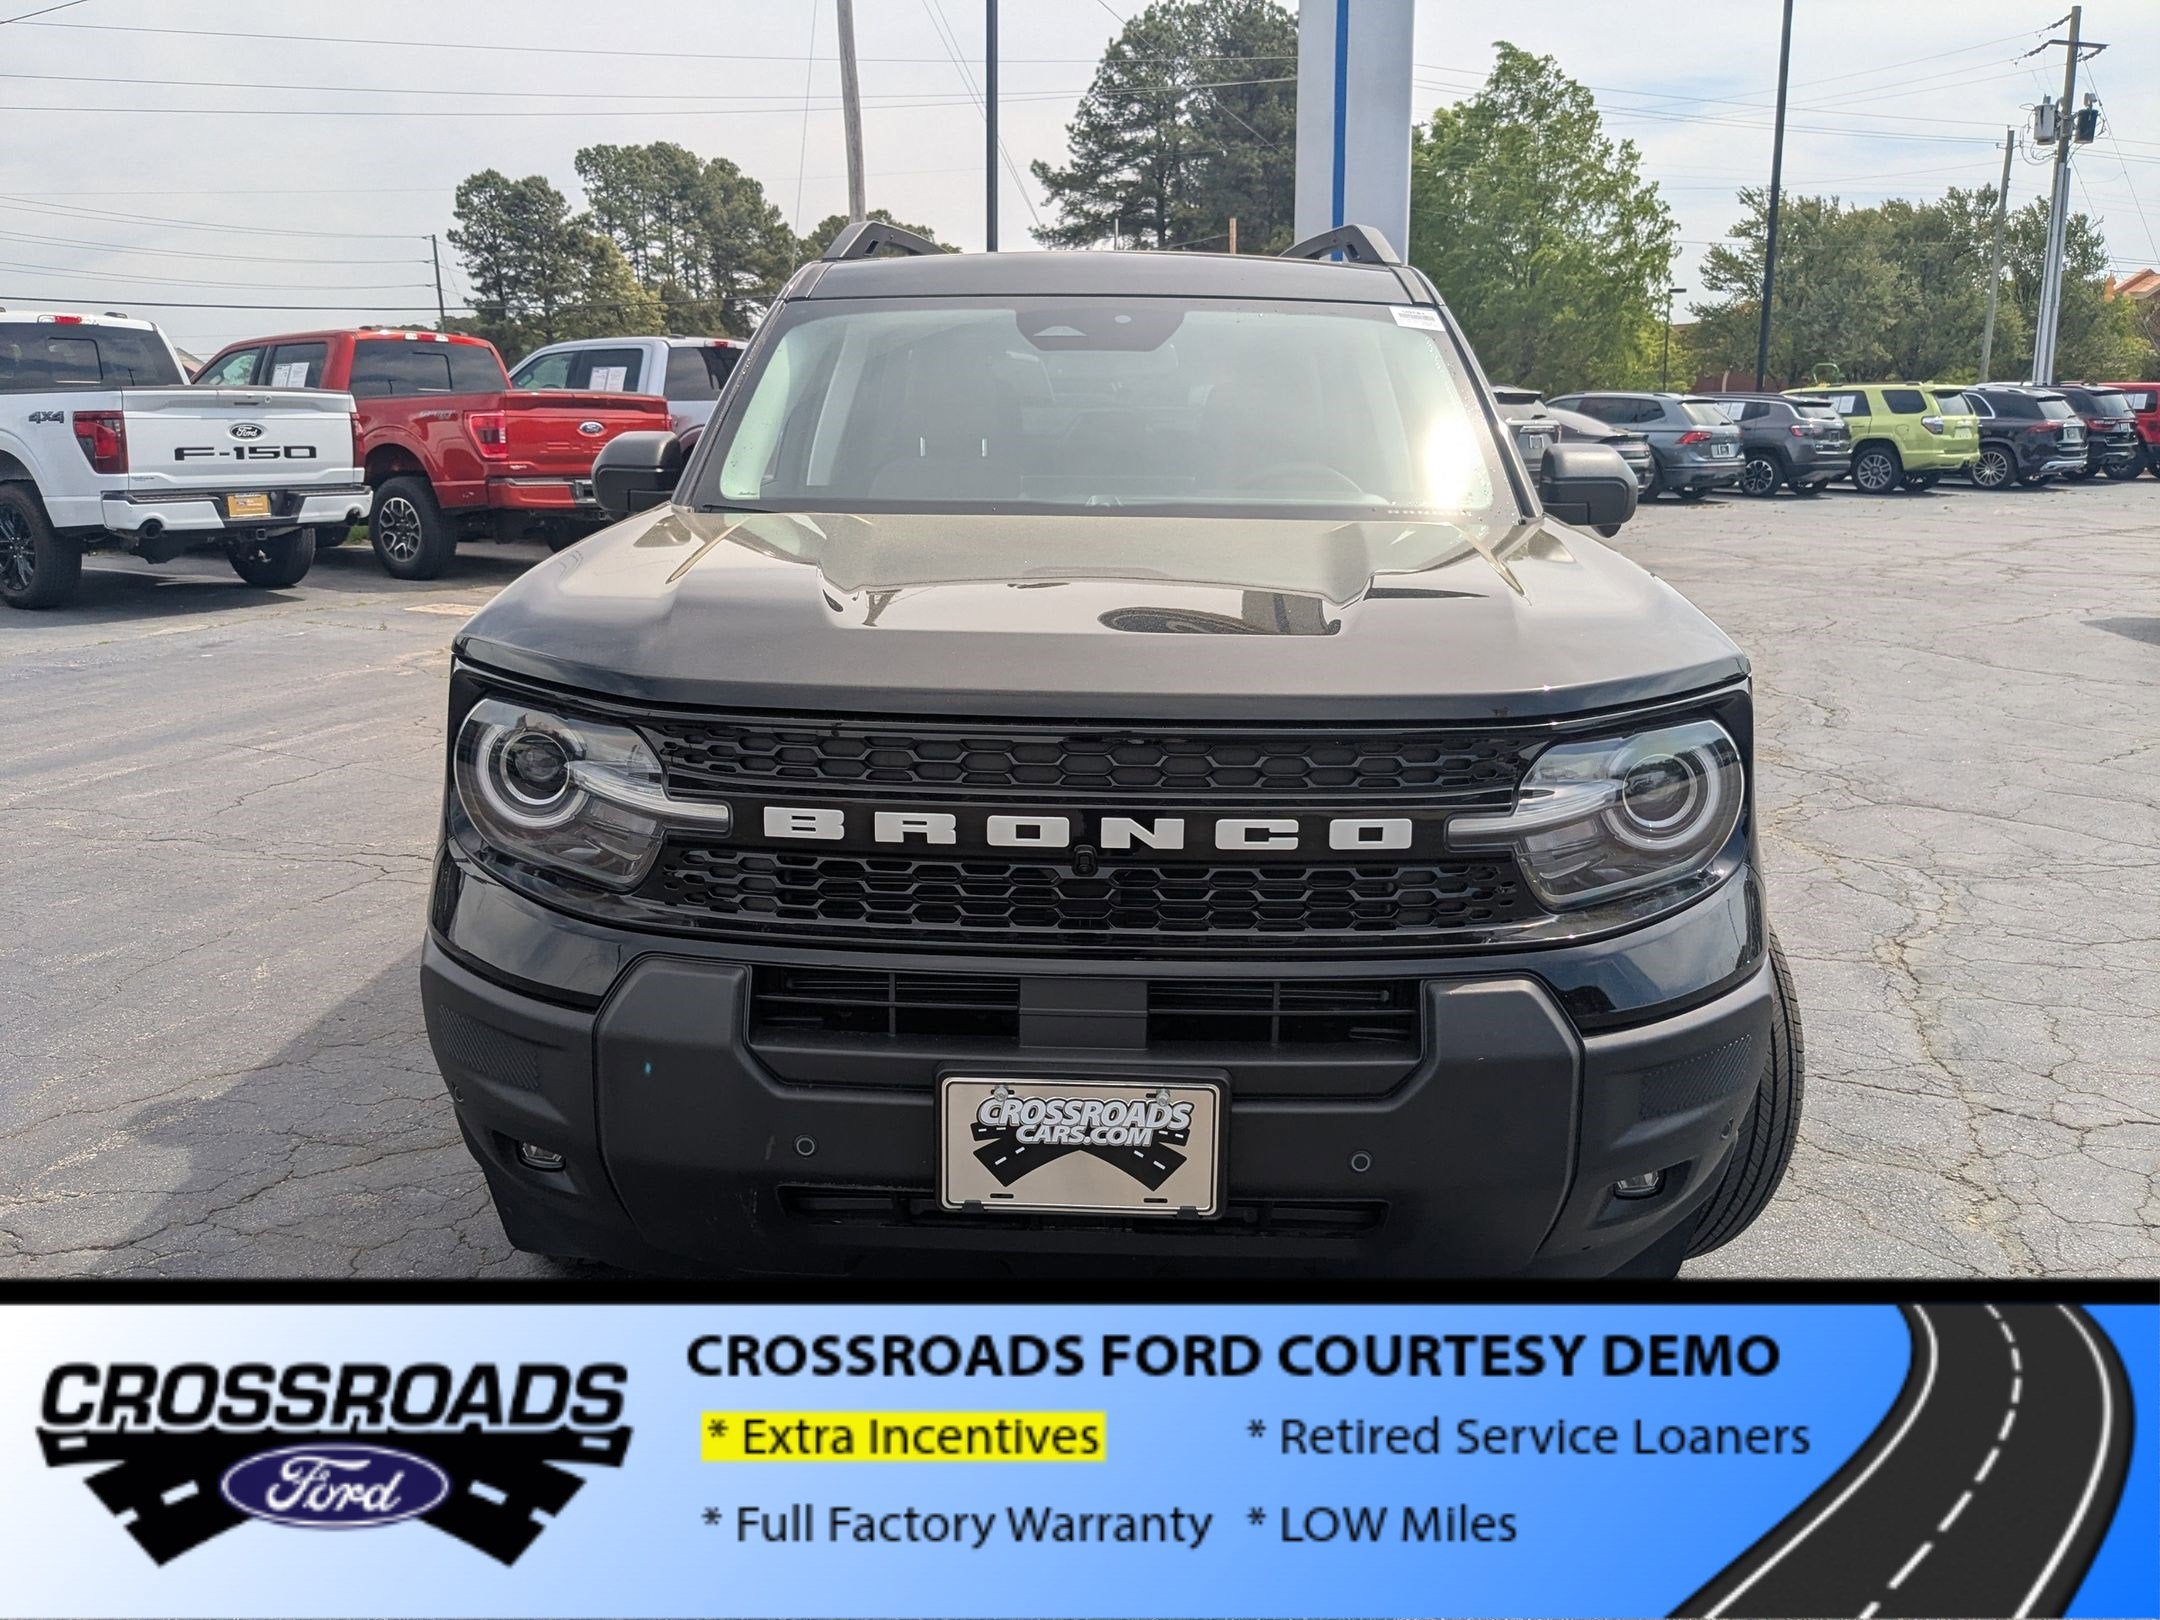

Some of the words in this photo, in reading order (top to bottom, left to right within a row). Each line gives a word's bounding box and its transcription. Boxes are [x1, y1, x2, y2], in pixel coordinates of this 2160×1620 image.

[174, 445, 317, 462] F-150
[763, 804, 1412, 851] BRONCO
[978, 1097, 1193, 1130] CROSSROADS
[1015, 1125, 1153, 1147] CARS.COM
